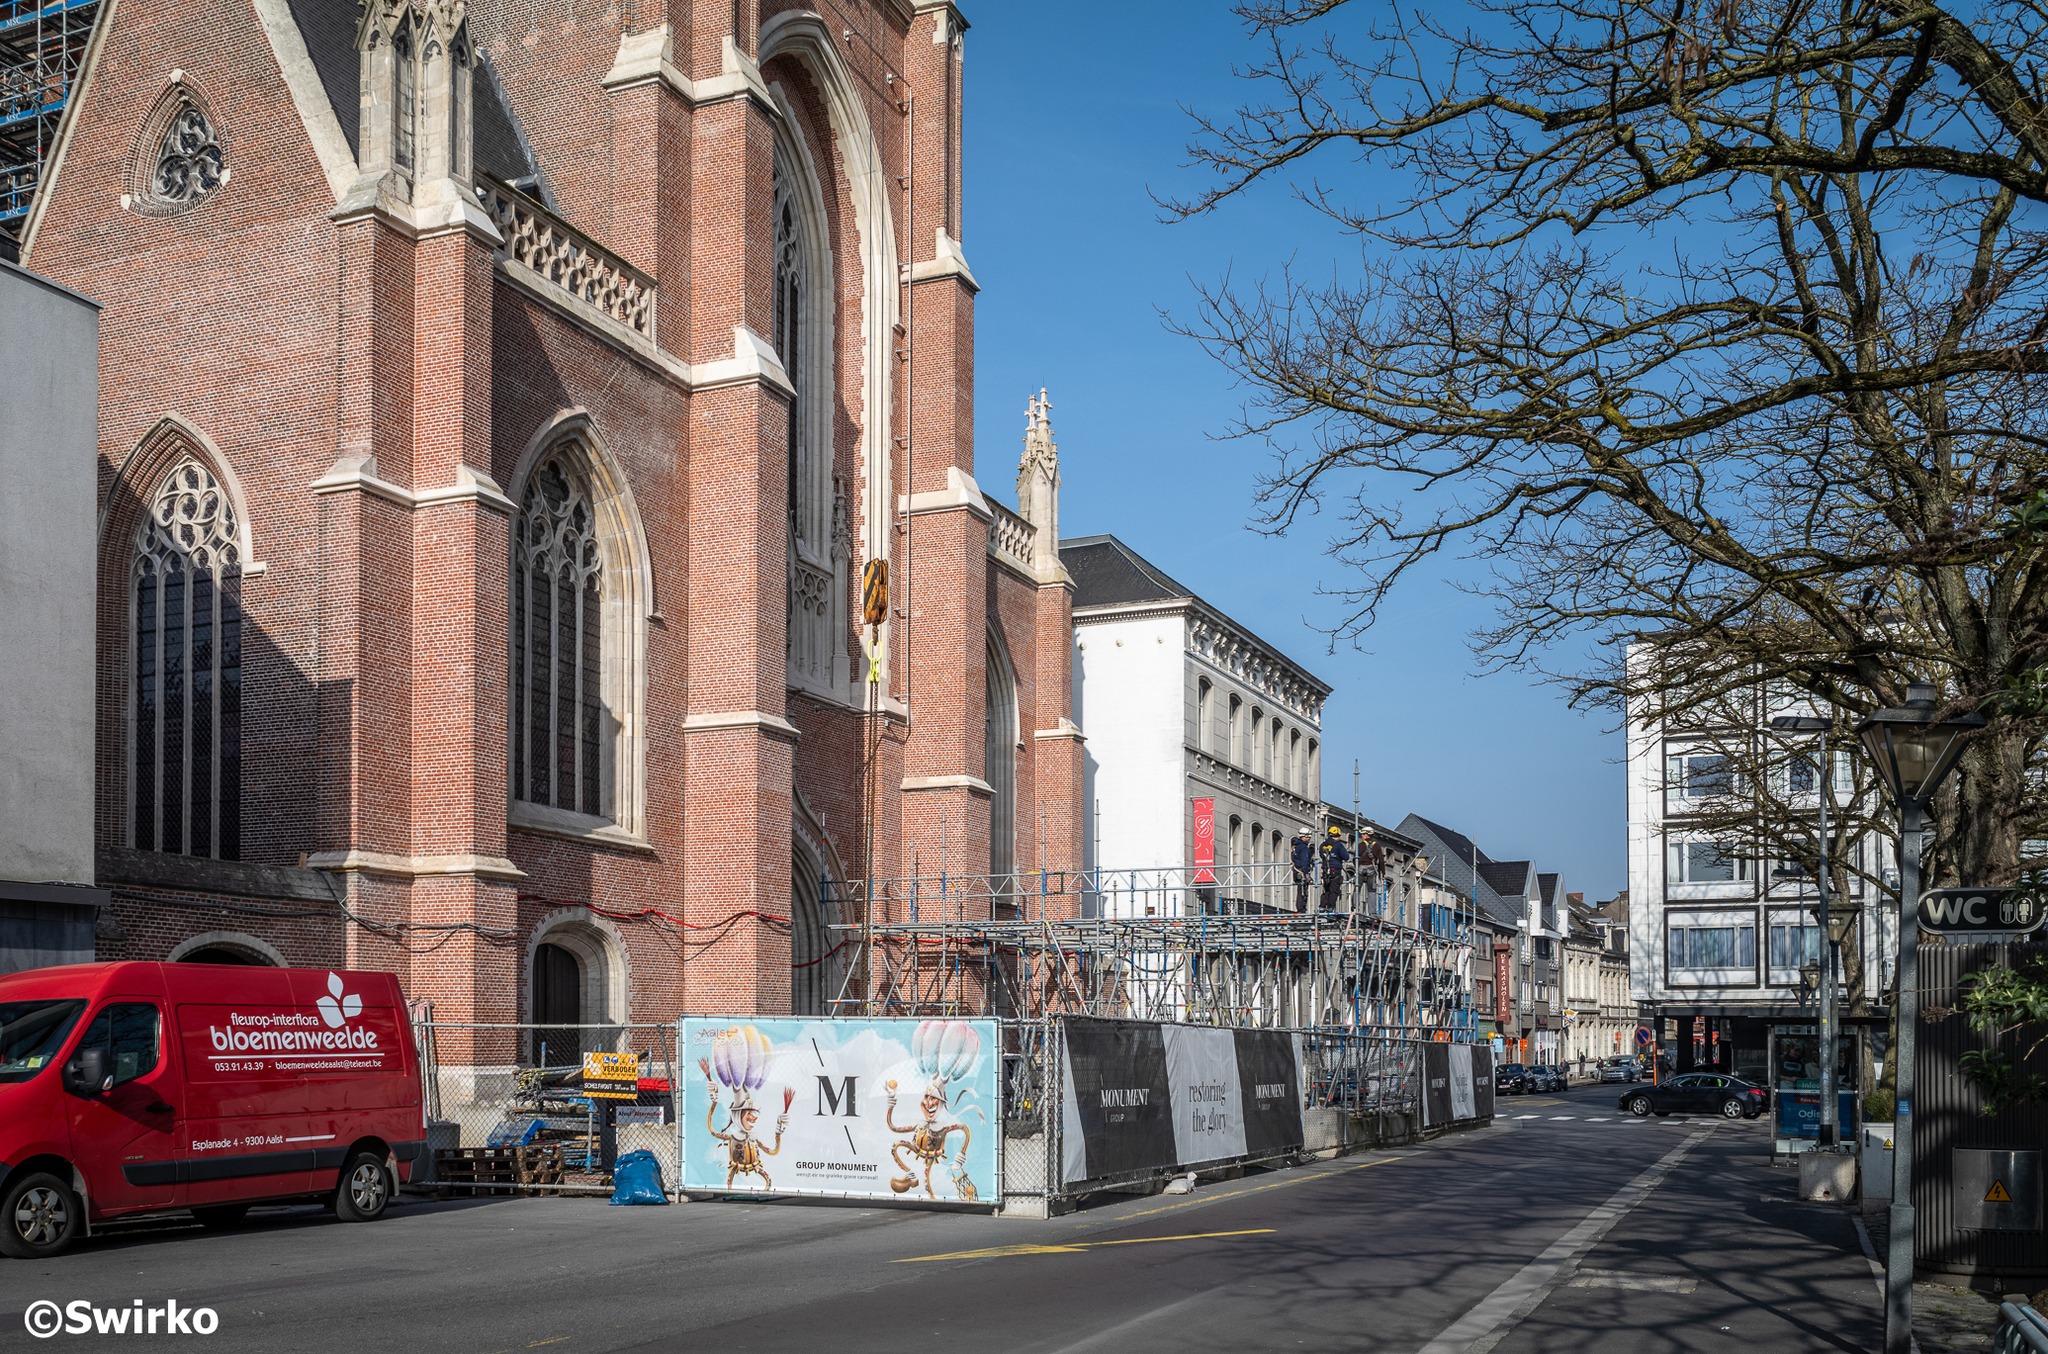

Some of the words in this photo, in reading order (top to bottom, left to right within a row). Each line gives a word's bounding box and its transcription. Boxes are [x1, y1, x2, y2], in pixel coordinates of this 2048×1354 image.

[5, 207, 21, 216] MSC
[1926, 897, 1987, 925] WC
[231, 1013, 319, 1028] fleurop-interflora
[209, 1025, 378, 1050] bloemenweelde
[215, 1062, 264, 1071] 053.21.43.39
[275, 1059, 382, 1070] bloemenweeldeaalst@telenet.be
[603, 1065, 637, 1073] VERBODEN
[813, 1075, 861, 1117] M
[1100, 1088, 1150, 1107] MONUMENT
[1188, 1079, 1226, 1107] restoring
[1192, 1108, 1206, 1133] the
[1208, 1107, 1228, 1135] glory
[1798, 1109, 1820, 1118] Odis
[192, 1139, 232, 1151] Esplanade
[233, 1138, 239, 1147] 4
[245, 1136, 264, 1146] 9300
[265, 1134, 284, 1144] Aalst
[796, 1161, 825, 1170] GROUP
[827, 1162, 878, 1172] MONUMENT
